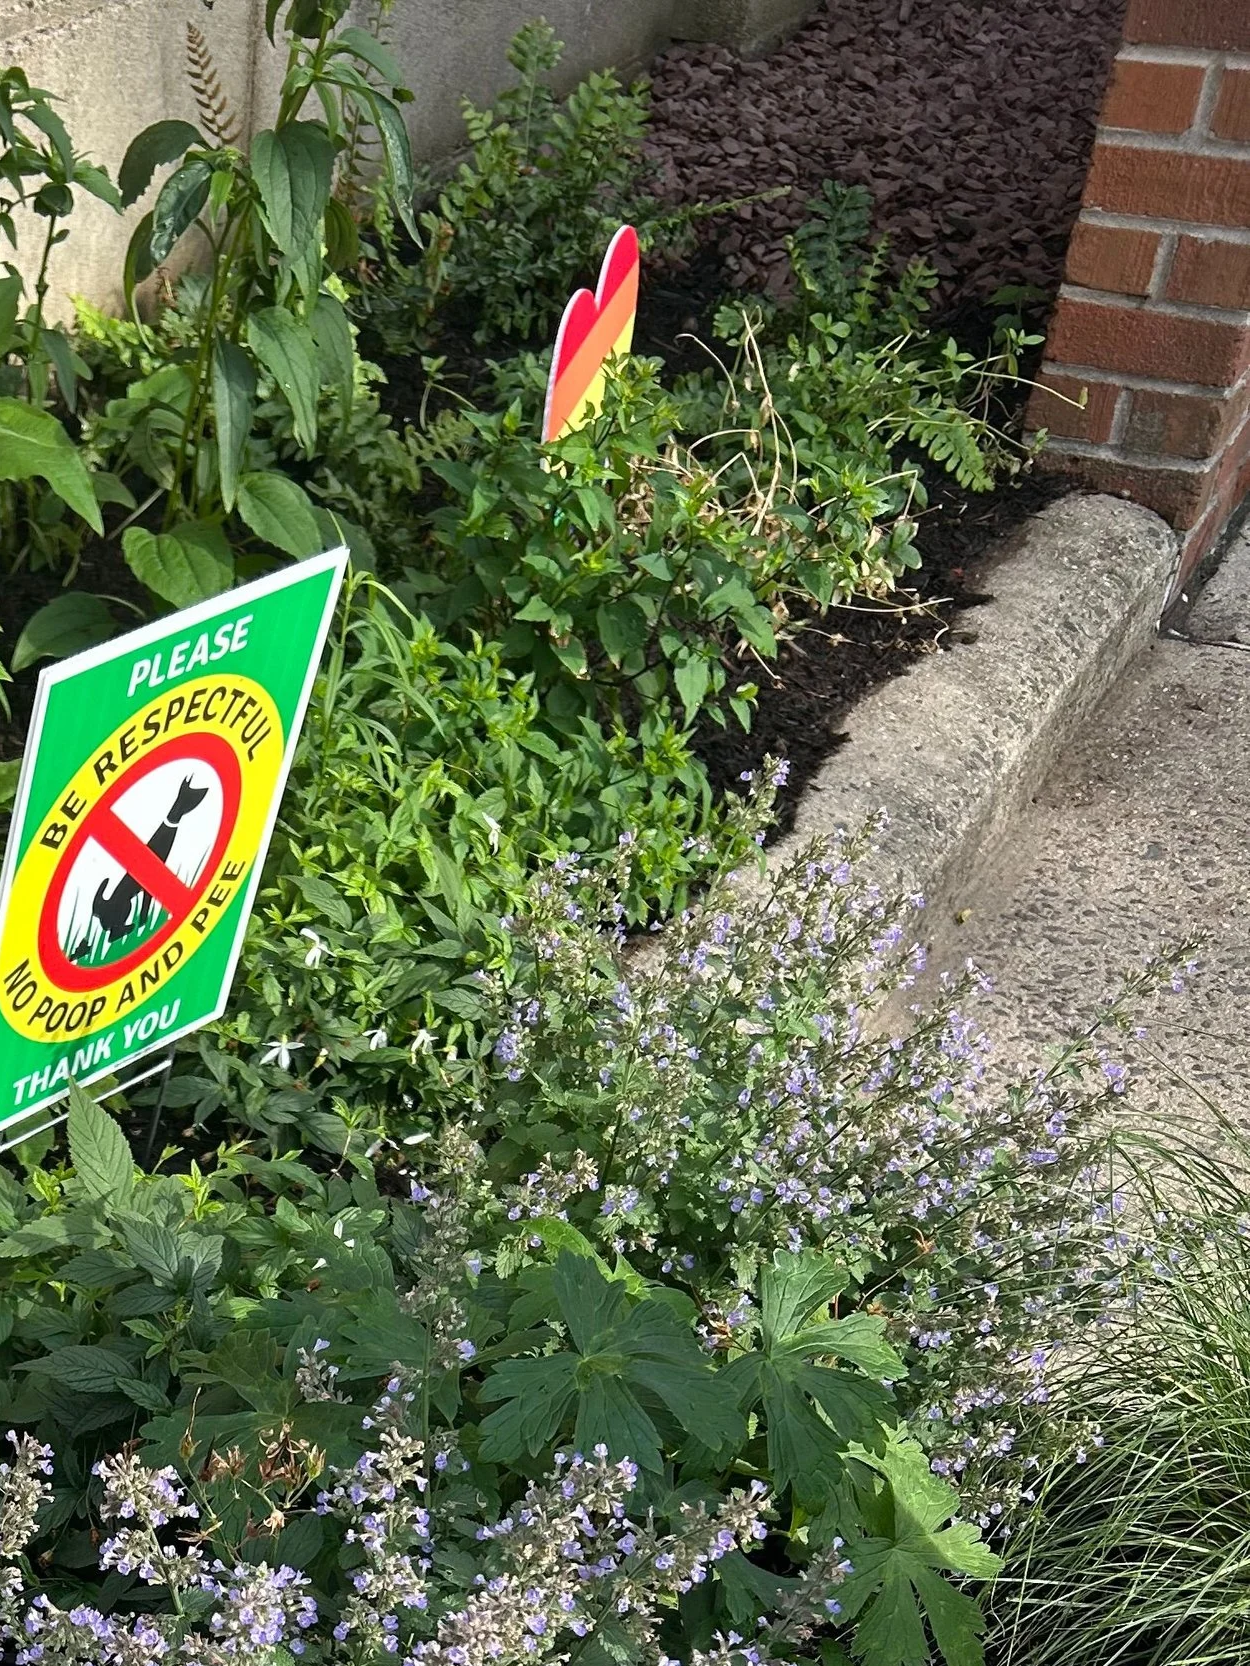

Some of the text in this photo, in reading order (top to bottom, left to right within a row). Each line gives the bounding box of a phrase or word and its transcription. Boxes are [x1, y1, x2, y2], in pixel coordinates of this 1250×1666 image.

[127, 615, 254, 697] PLEASE
[40, 686, 272, 849] BE RESPECTFUL
[3, 860, 246, 1033] NO POOP AND PEE
[13, 1031, 115, 1106] THANK
[123, 998, 181, 1050] YOU
